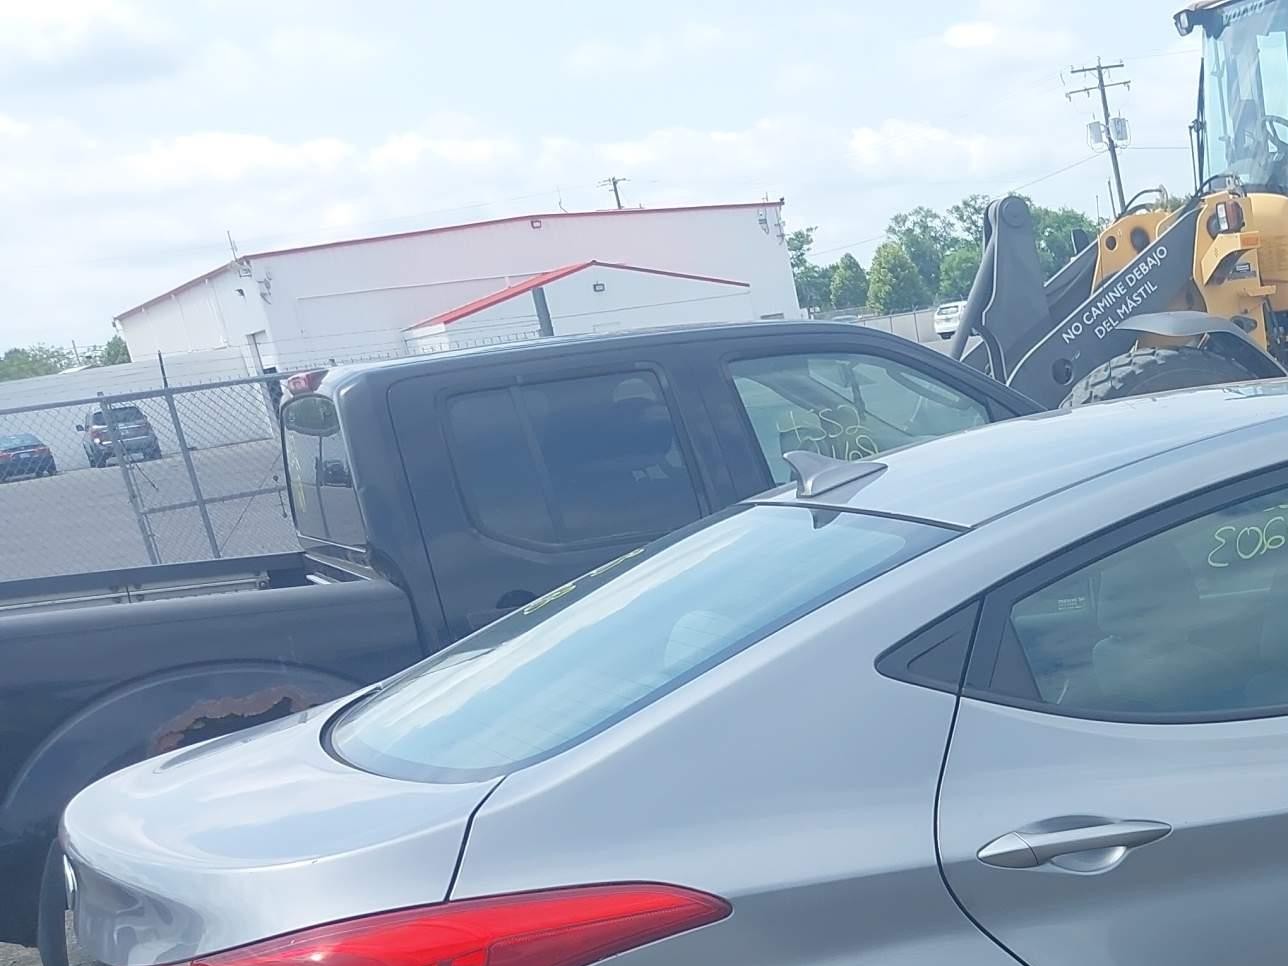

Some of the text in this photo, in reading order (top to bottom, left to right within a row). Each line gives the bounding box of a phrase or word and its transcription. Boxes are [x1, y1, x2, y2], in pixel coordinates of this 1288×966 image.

[1062, 246, 1168, 345] NO CAMINE DEBAJO
[1094, 280, 1158, 340] DEL MÁSTIL
